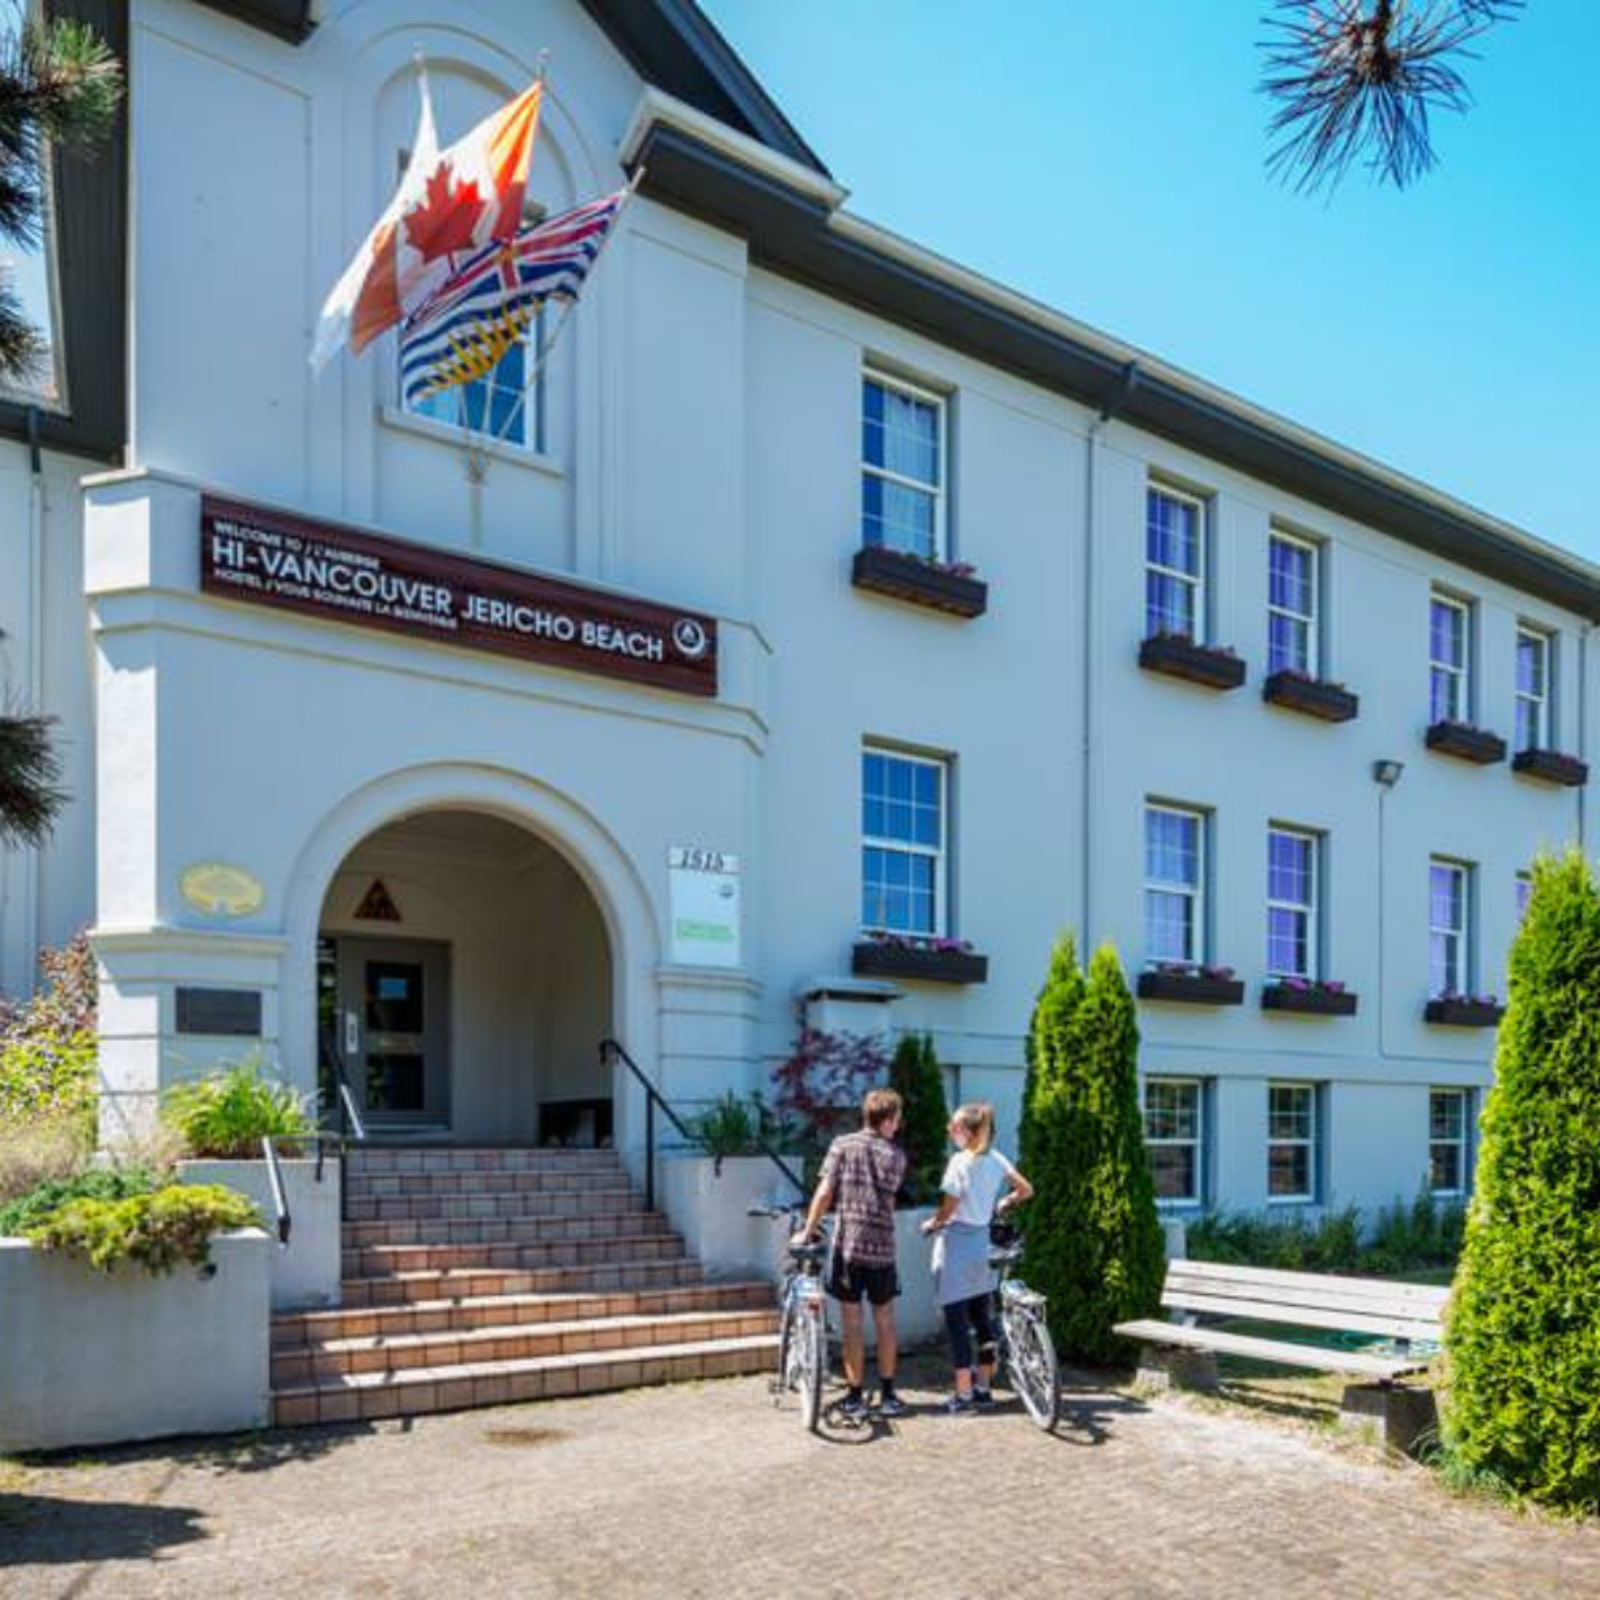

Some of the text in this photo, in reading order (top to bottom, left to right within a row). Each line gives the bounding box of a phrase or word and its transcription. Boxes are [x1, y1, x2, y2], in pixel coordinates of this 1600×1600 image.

[213, 535, 663, 661] HI-VANCOUVER JERICHO BEACH
